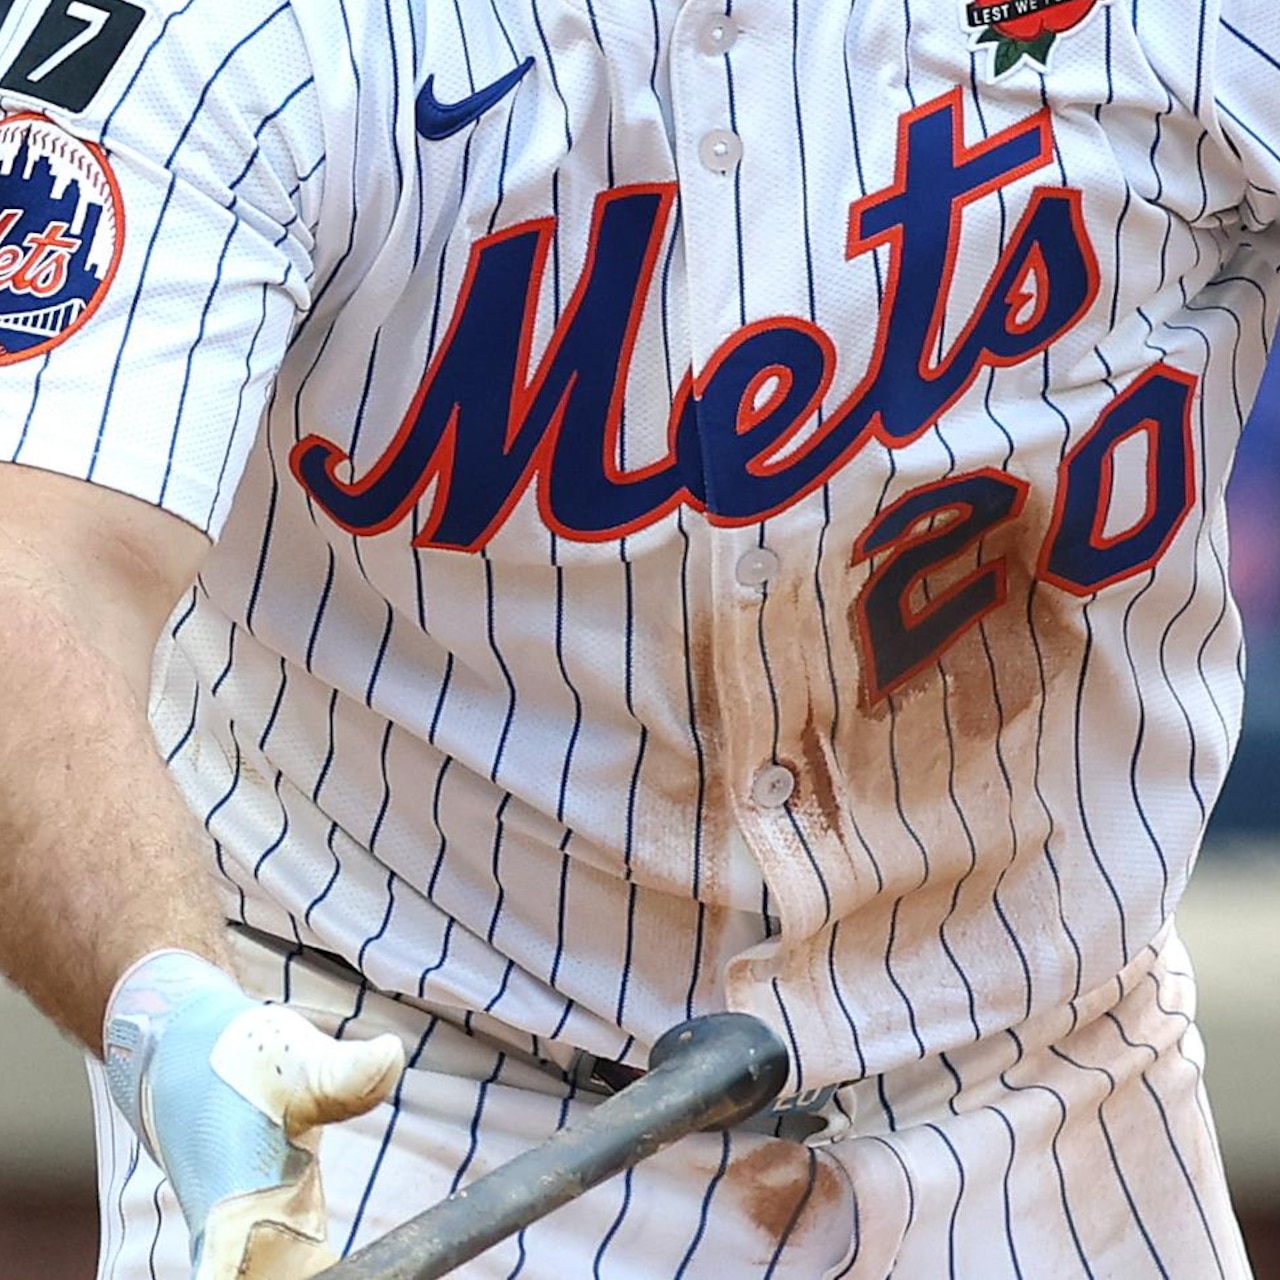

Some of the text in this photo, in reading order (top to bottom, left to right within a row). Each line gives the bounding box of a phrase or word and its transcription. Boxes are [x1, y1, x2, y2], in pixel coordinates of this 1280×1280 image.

[27, 1, 111, 83] 7
[973, 4, 1009, 24] LEST
[290, 86, 1099, 554] Mets
[851, 362, 1199, 707] 20
